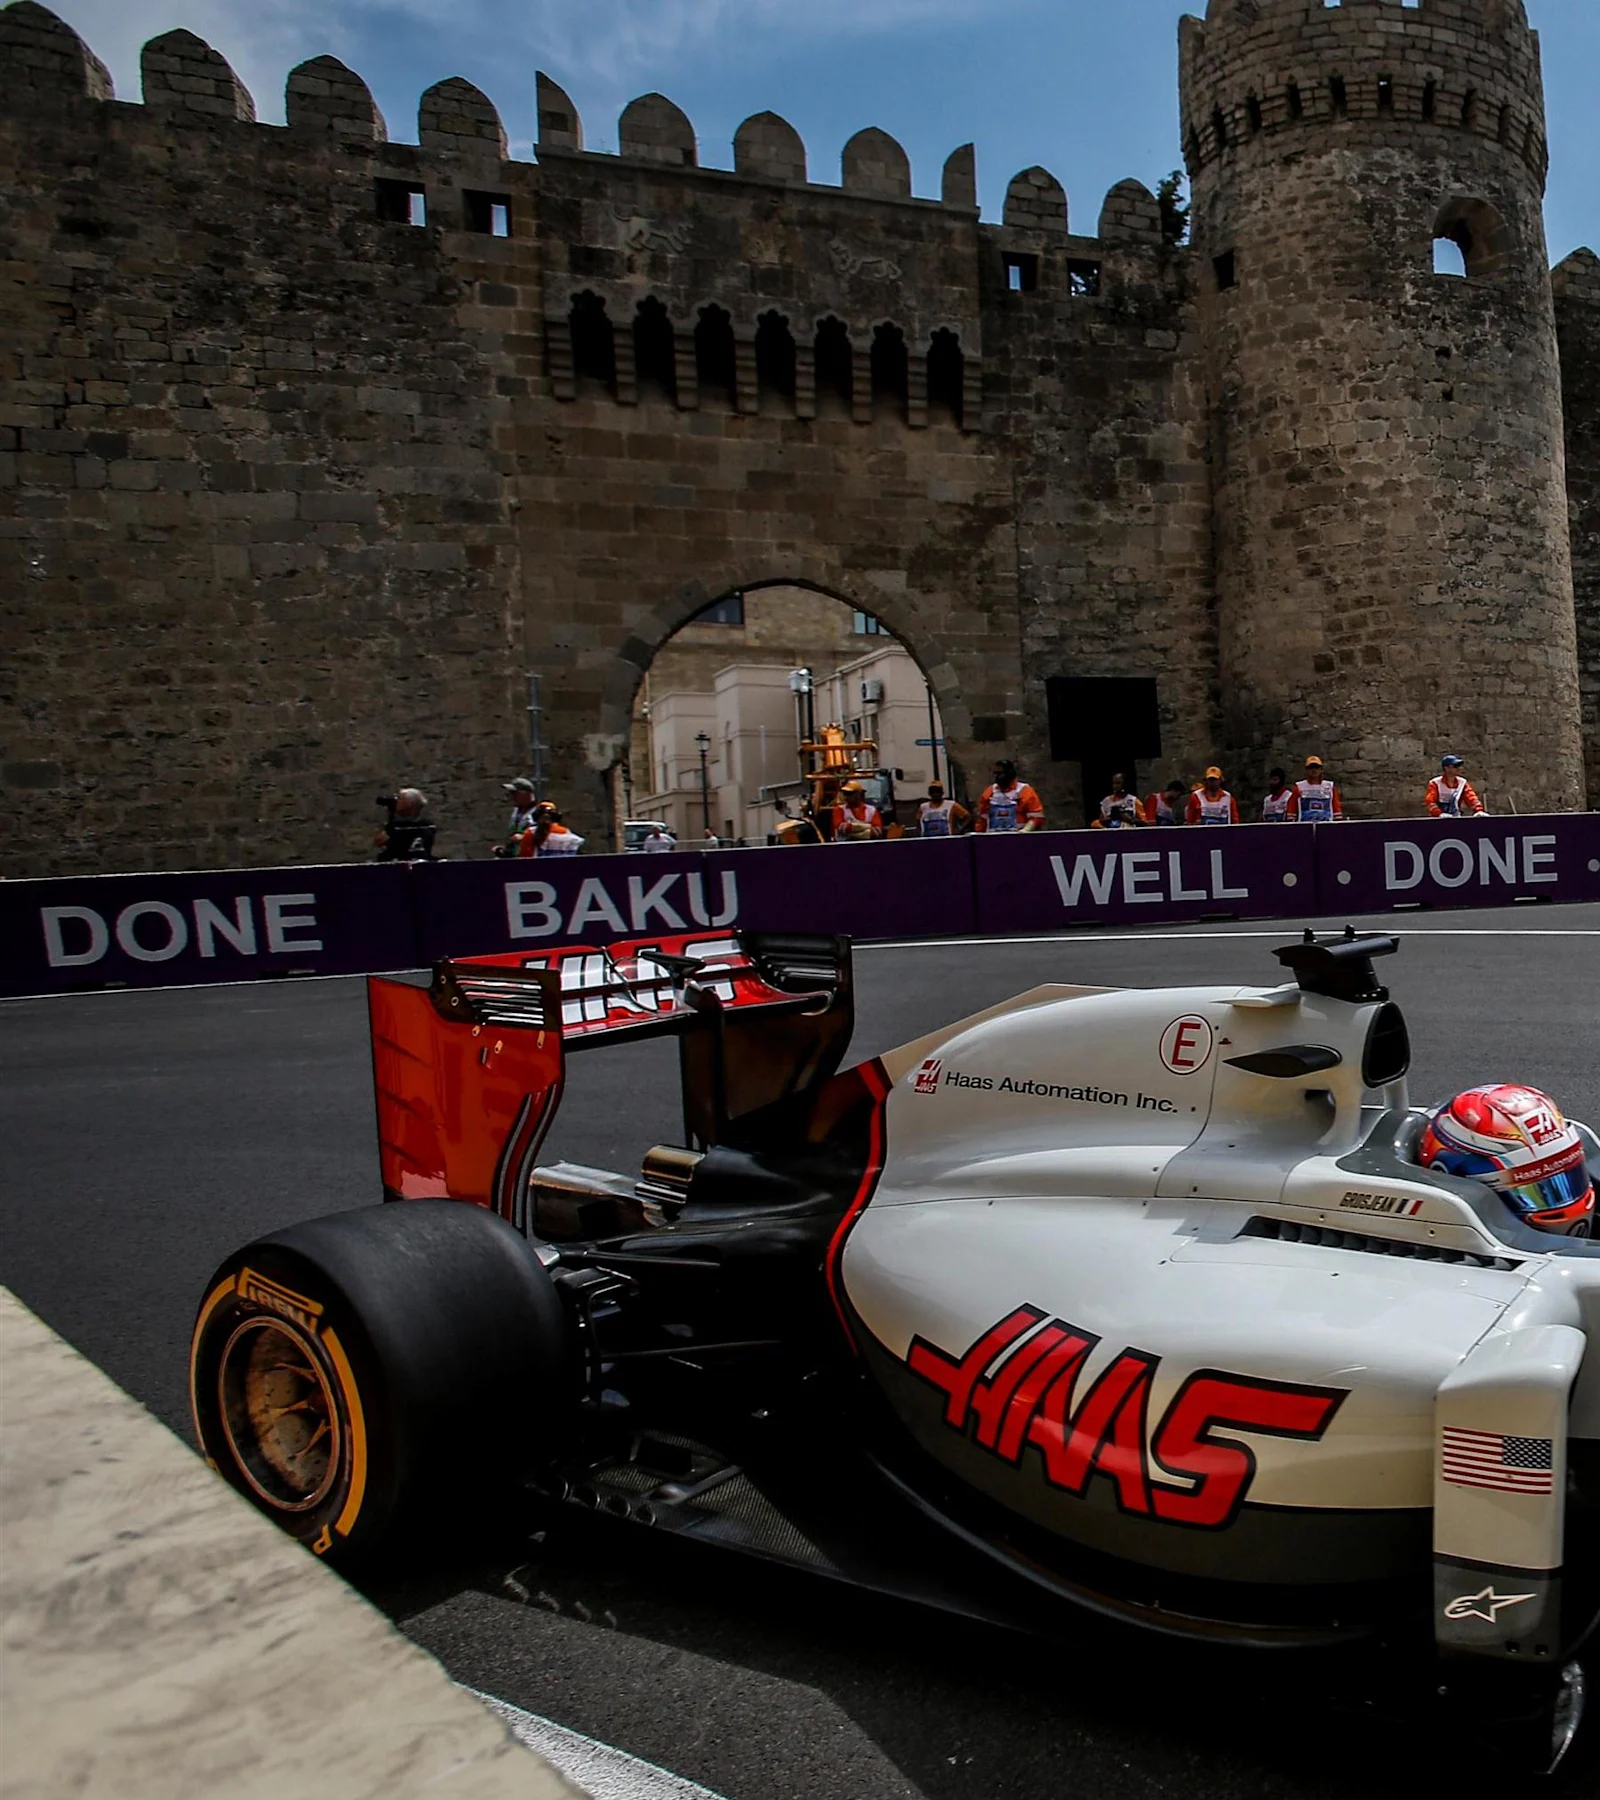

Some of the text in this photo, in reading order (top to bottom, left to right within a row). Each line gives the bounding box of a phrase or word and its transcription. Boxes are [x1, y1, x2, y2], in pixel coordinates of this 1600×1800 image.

[1050, 848, 1249, 907] WELL
[1384, 834, 1559, 891] DONE
[40, 869, 740, 968] DONE BAKU
[1171, 1021, 1201, 1067] E
[945, 1071, 1178, 1114] Haas Automation Inc.
[1513, 1168, 1542, 1181] Haas
[237, 1266, 325, 1335] PIRELLI
[905, 1302, 1352, 1531] HAAS
